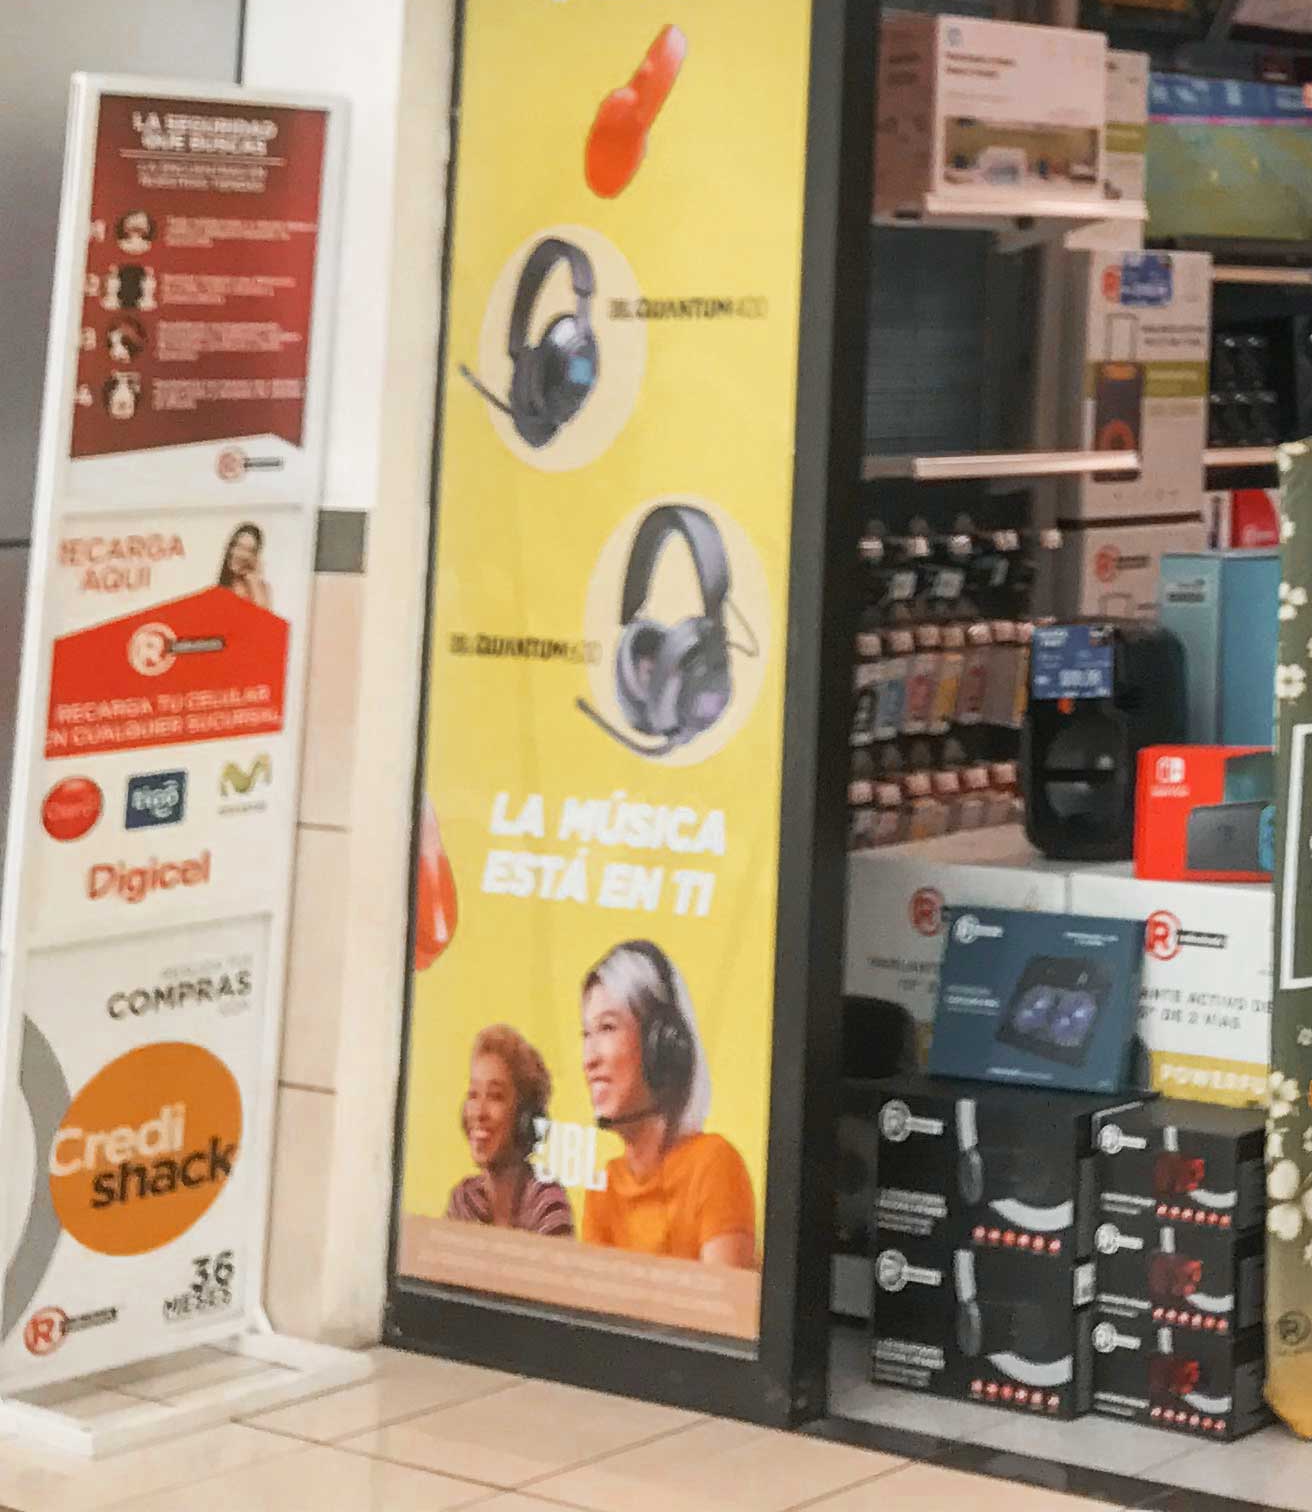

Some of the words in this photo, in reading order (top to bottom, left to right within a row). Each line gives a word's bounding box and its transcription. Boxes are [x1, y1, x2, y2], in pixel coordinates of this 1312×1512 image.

[489, 790, 546, 838] LA
[556, 788, 727, 857] MÚSICA
[480, 846, 590, 905] ESTÁ
[596, 860, 665, 913] EN
[670, 868, 717, 918] TI
[106, 969, 253, 1021] COMPRAS
[49, 1100, 187, 1178] Credi
[90, 1134, 236, 1210] shack
[193, 1249, 235, 1293] 36
